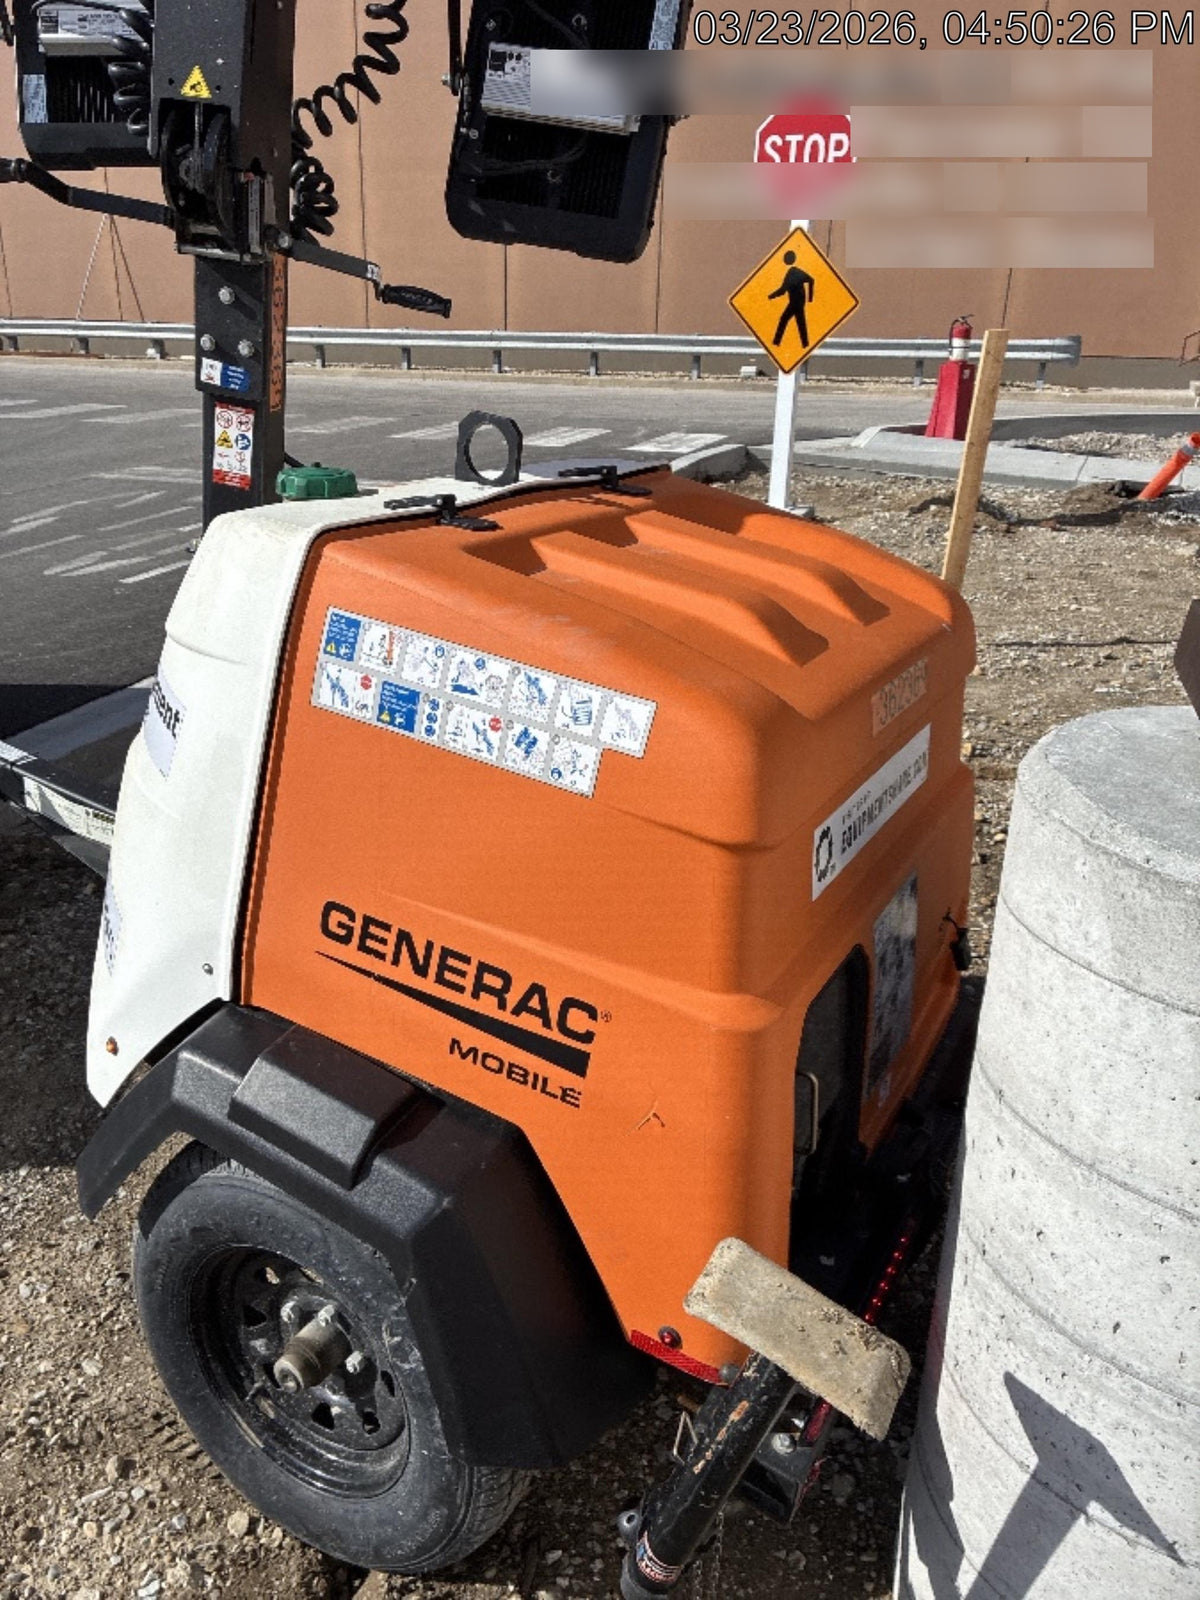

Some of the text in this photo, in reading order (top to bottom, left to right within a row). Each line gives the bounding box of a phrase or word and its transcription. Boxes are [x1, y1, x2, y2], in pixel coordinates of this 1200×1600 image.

[763, 132, 851, 163] STOP
[320, 900, 599, 1045] GENERAC
[449, 1036, 583, 1109] MOBILE
